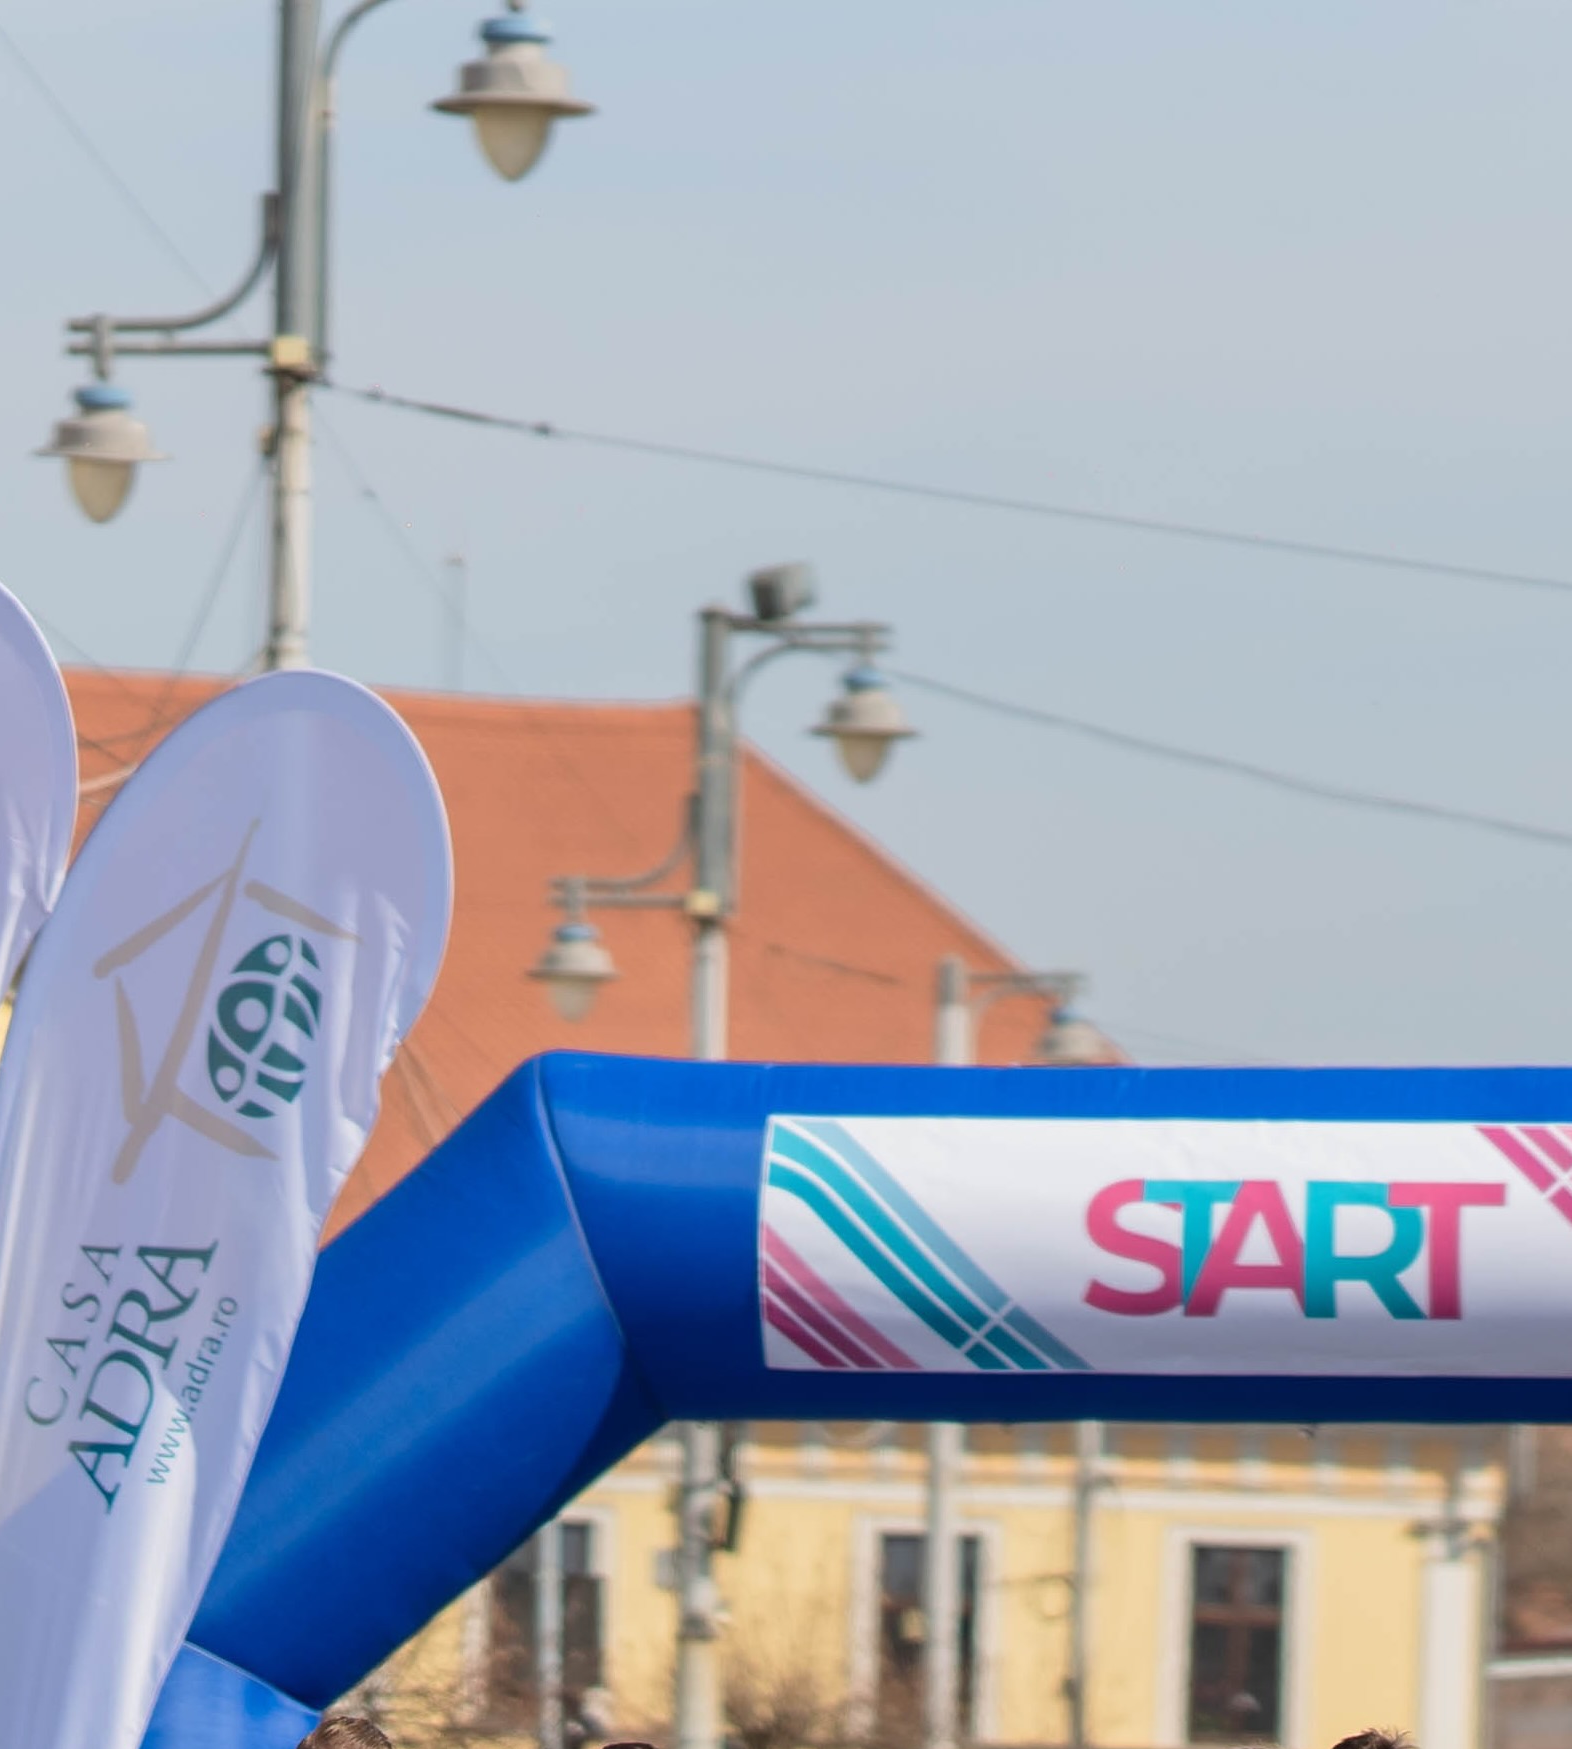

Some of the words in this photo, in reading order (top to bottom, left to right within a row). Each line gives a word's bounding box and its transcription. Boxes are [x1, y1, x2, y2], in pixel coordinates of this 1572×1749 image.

[24, 1243, 123, 1426] CASA
[1083, 1177, 1507, 1321] START
[68, 1238, 220, 1516] ADRA
[145, 1296, 239, 1486] www.adra.ro
